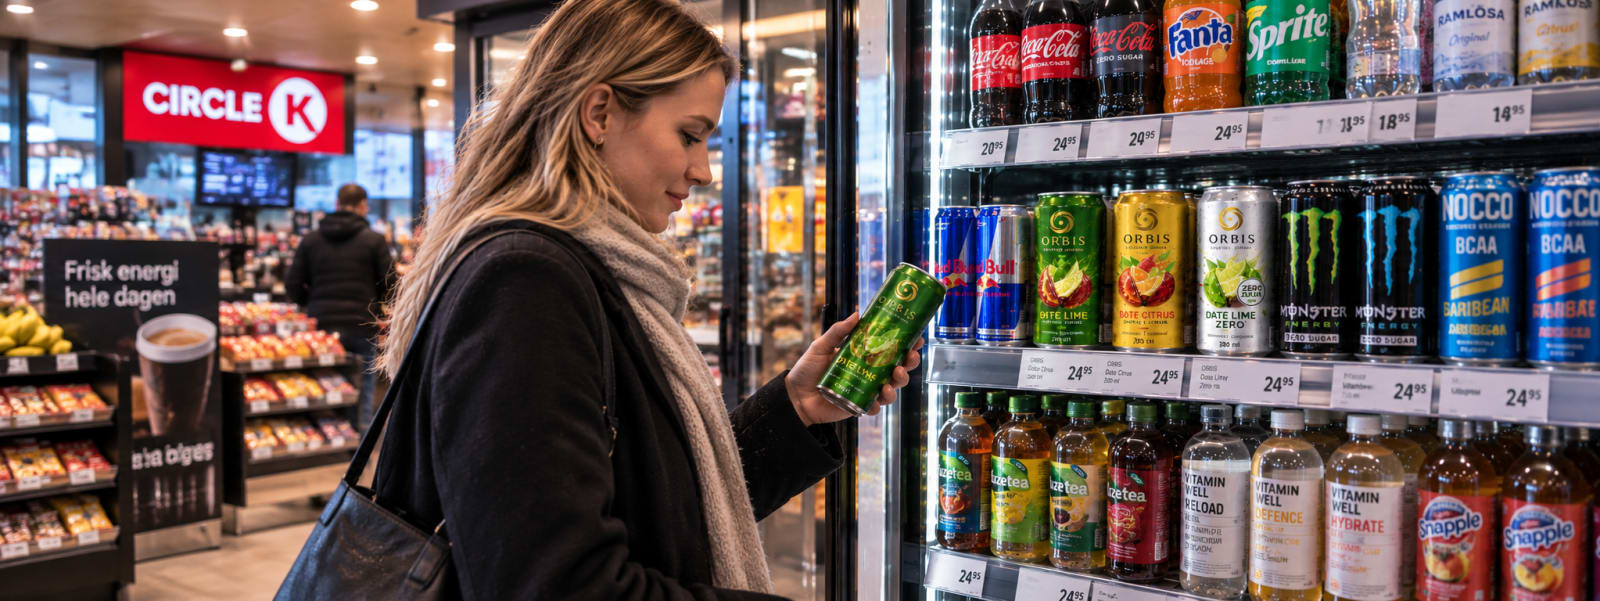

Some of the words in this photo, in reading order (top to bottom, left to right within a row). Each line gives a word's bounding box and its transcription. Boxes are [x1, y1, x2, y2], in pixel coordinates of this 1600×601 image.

[1438, 5, 1505, 27] RAMLÖSA
[1168, 18, 1233, 60] Fanta
[1247, 4, 1328, 61] Sprite
[1117, 53, 1144, 61] SUGAR
[143, 82, 263, 123] CIRCLE
[1442, 192, 1513, 221] NOCCO
[1529, 188, 1600, 219] NOCCO
[1041, 236, 1086, 246] ORBIS
[1123, 234, 1170, 244] ORBIS
[1209, 234, 1255, 244] ORBIS
[1455, 236, 1497, 254] BCAA
[1541, 234, 1586, 253] BCAA
[65, 259, 113, 281] Frisk
[117, 259, 179, 286] energi
[986, 259, 1015, 275] Bull
[65, 285, 110, 308] hele
[114, 284, 176, 311] dagen
[1064, 311, 1088, 320] LIME
[1142, 311, 1175, 319] CITRUS
[1206, 311, 1229, 319] DATE
[1231, 311, 1256, 319] LIME
[1280, 303, 1347, 320] MONSTER
[1355, 304, 1426, 321] MONSTER
[1215, 320, 1244, 329] ZERO
[991, 472, 1029, 489] uzetea
[1050, 478, 1088, 496] uzetea
[1184, 473, 1226, 488] VITAMIN
[1255, 480, 1299, 496] VITAMIN
[1185, 485, 1209, 498] WELL
[1255, 493, 1282, 507] WELL
[1332, 486, 1379, 504] VITAMIN
[1185, 499, 1224, 515] RELOAD
[1255, 507, 1303, 524] DEFENCE
[1332, 500, 1360, 515] WELL
[1331, 514, 1384, 533] HYDRATE
[1419, 512, 1482, 540] Snapple
[1503, 521, 1575, 550] Snapple
